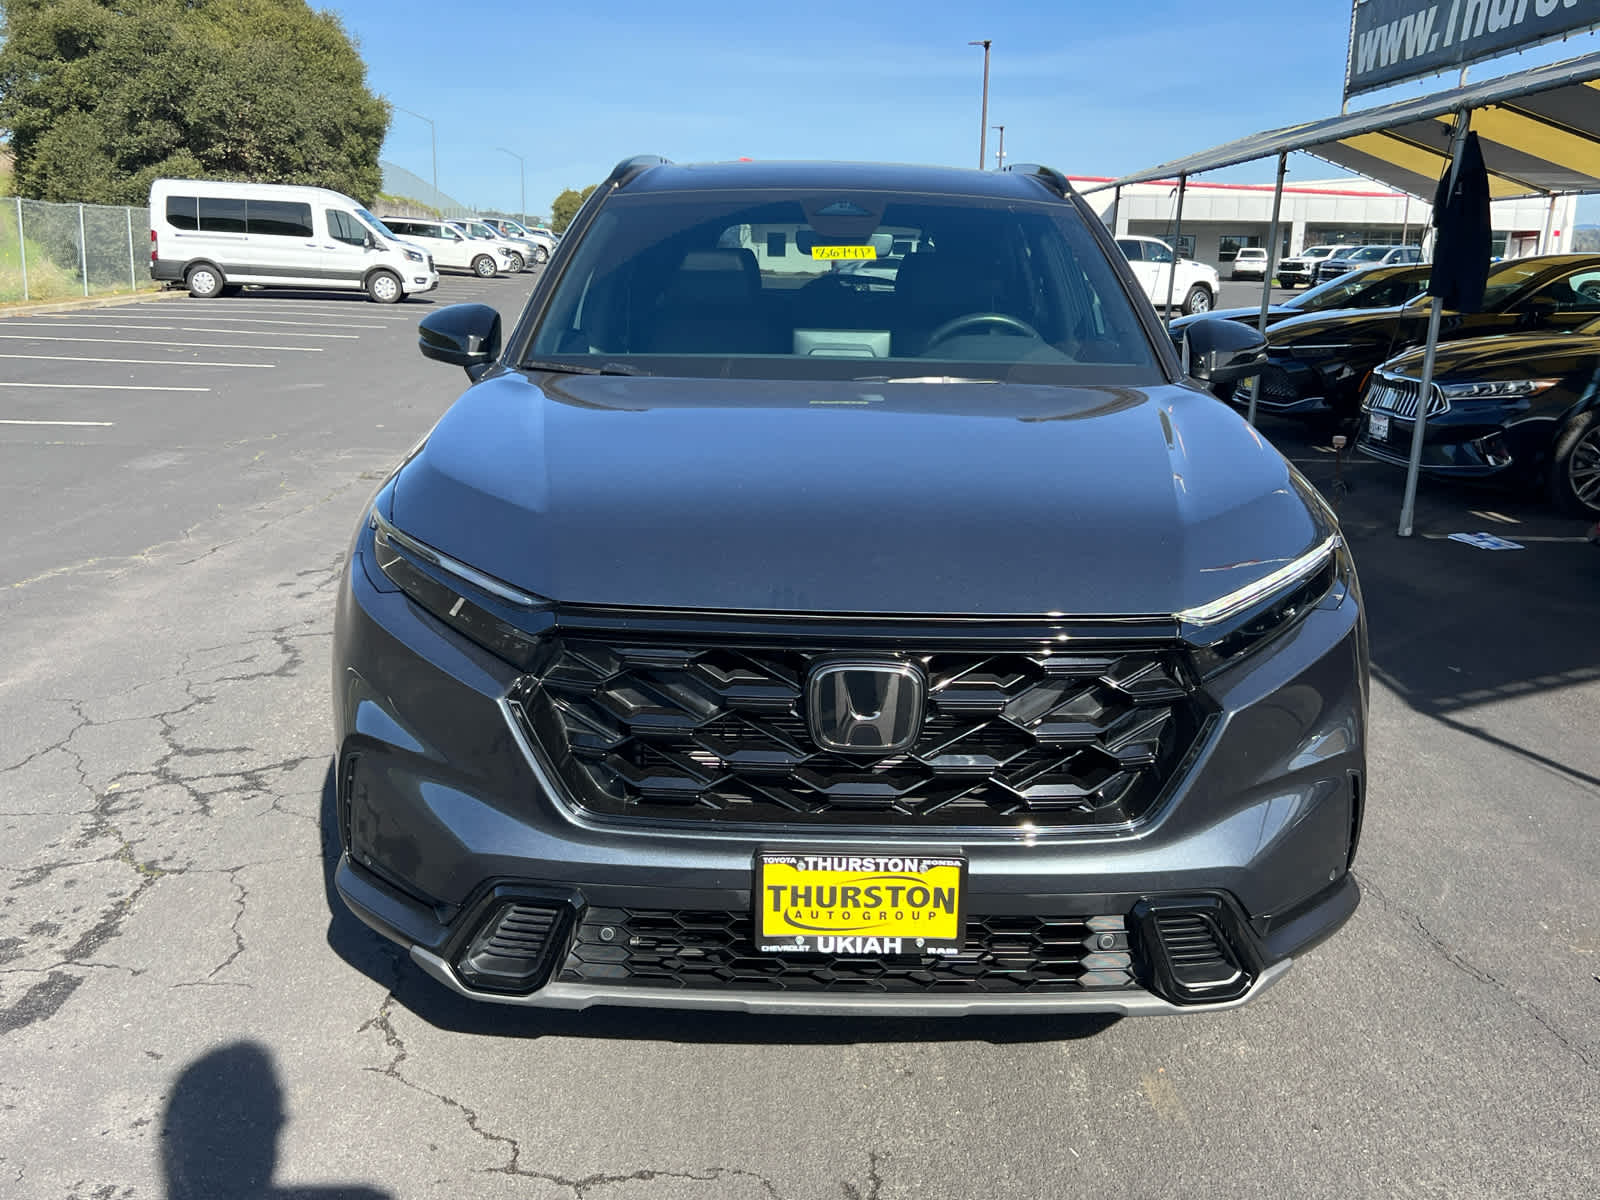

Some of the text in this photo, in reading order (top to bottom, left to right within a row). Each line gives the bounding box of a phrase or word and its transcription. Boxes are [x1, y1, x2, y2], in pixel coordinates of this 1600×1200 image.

[763, 857, 797, 865] TOYOTA
[805, 857, 918, 872] THURSTON
[767, 885, 955, 914] THURSTON
[817, 936, 902, 954] UKIAH
